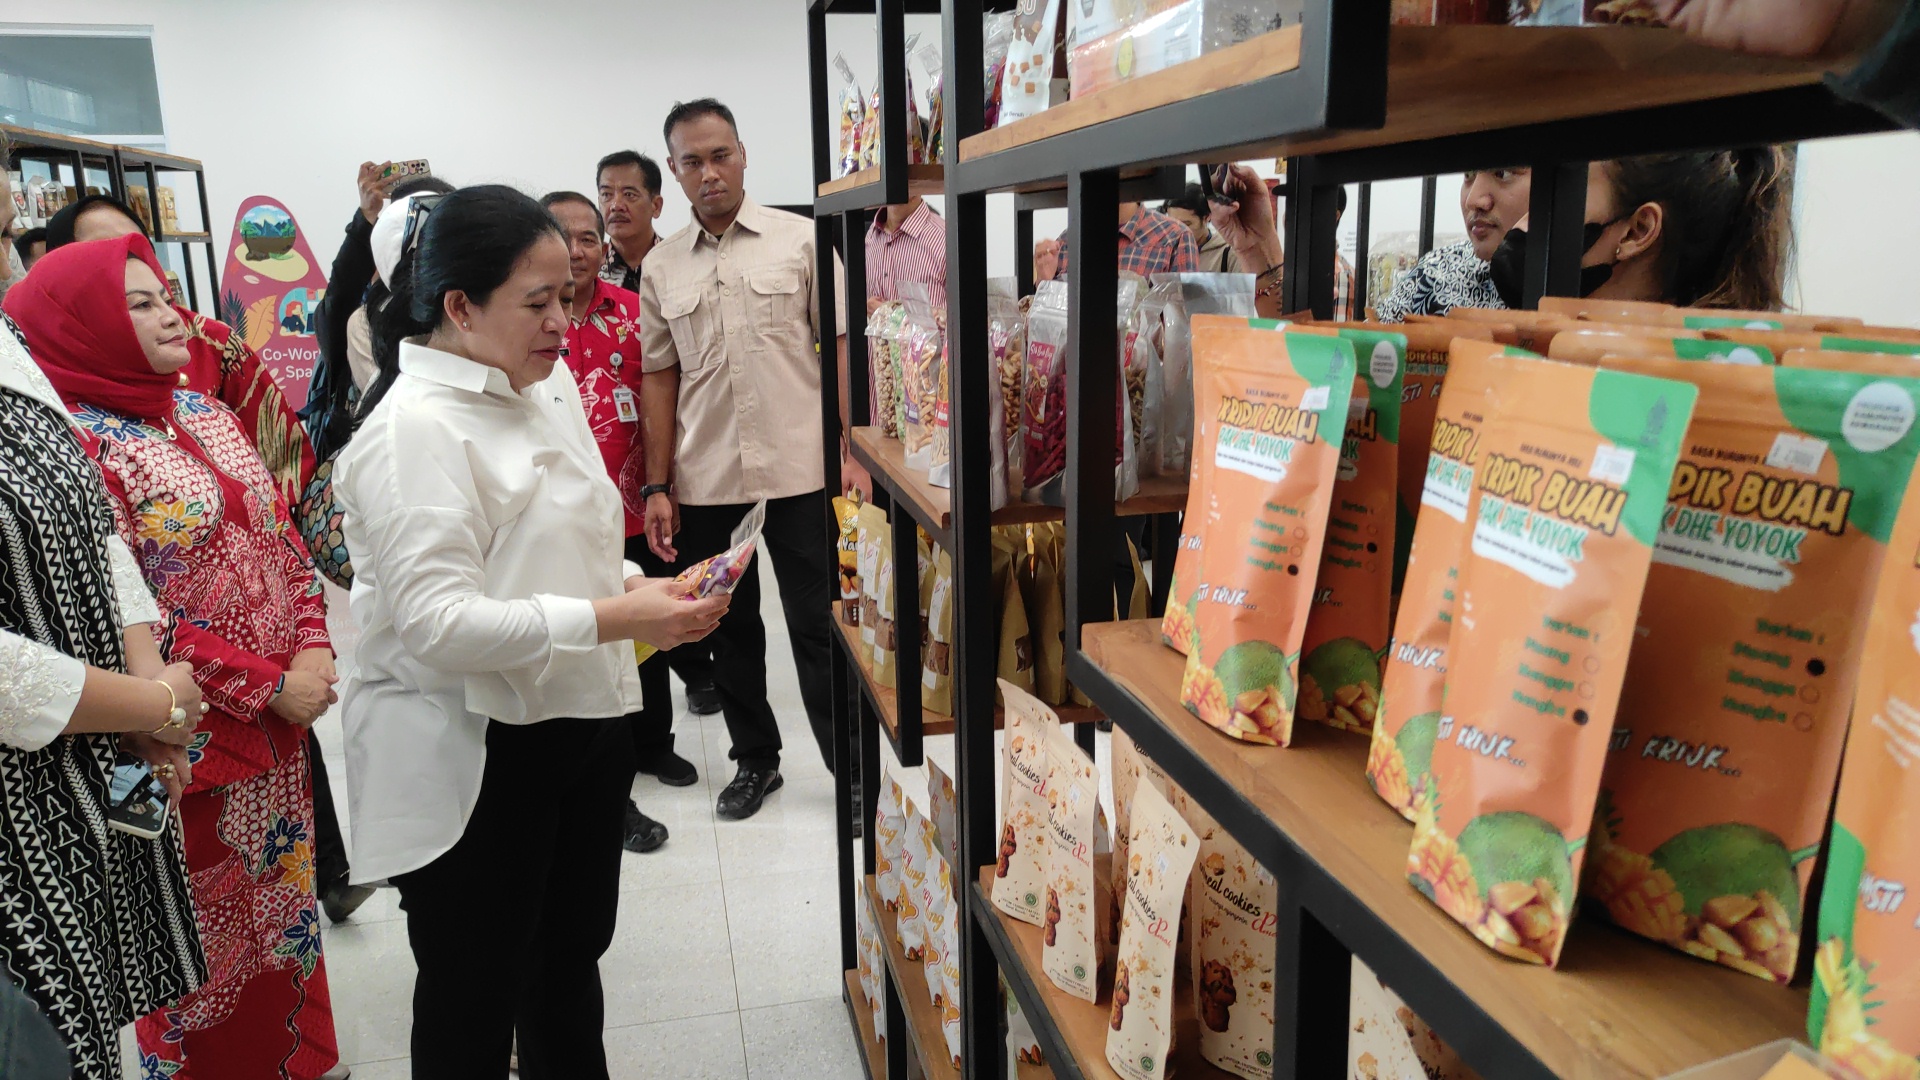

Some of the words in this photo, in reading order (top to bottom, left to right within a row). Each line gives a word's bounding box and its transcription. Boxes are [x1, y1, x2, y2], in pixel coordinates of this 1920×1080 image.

[262, 347, 321, 361] Co-Wor
[1261, 403, 1320, 444] BUAH
[1254, 434, 1294, 462] YOYOK
[1538, 470, 1629, 538] BUAH
[1732, 470, 1855, 537] BUAH
[1527, 512, 1588, 562] YOYOK
[1673, 508, 1720, 544] DHE
[1720, 516, 1809, 562] YOYOK
[1017, 761, 1041, 785] cookies
[1053, 821, 1078, 847] cookies
[1135, 891, 1158, 922] cookies
[1223, 886, 1262, 917] cookies
